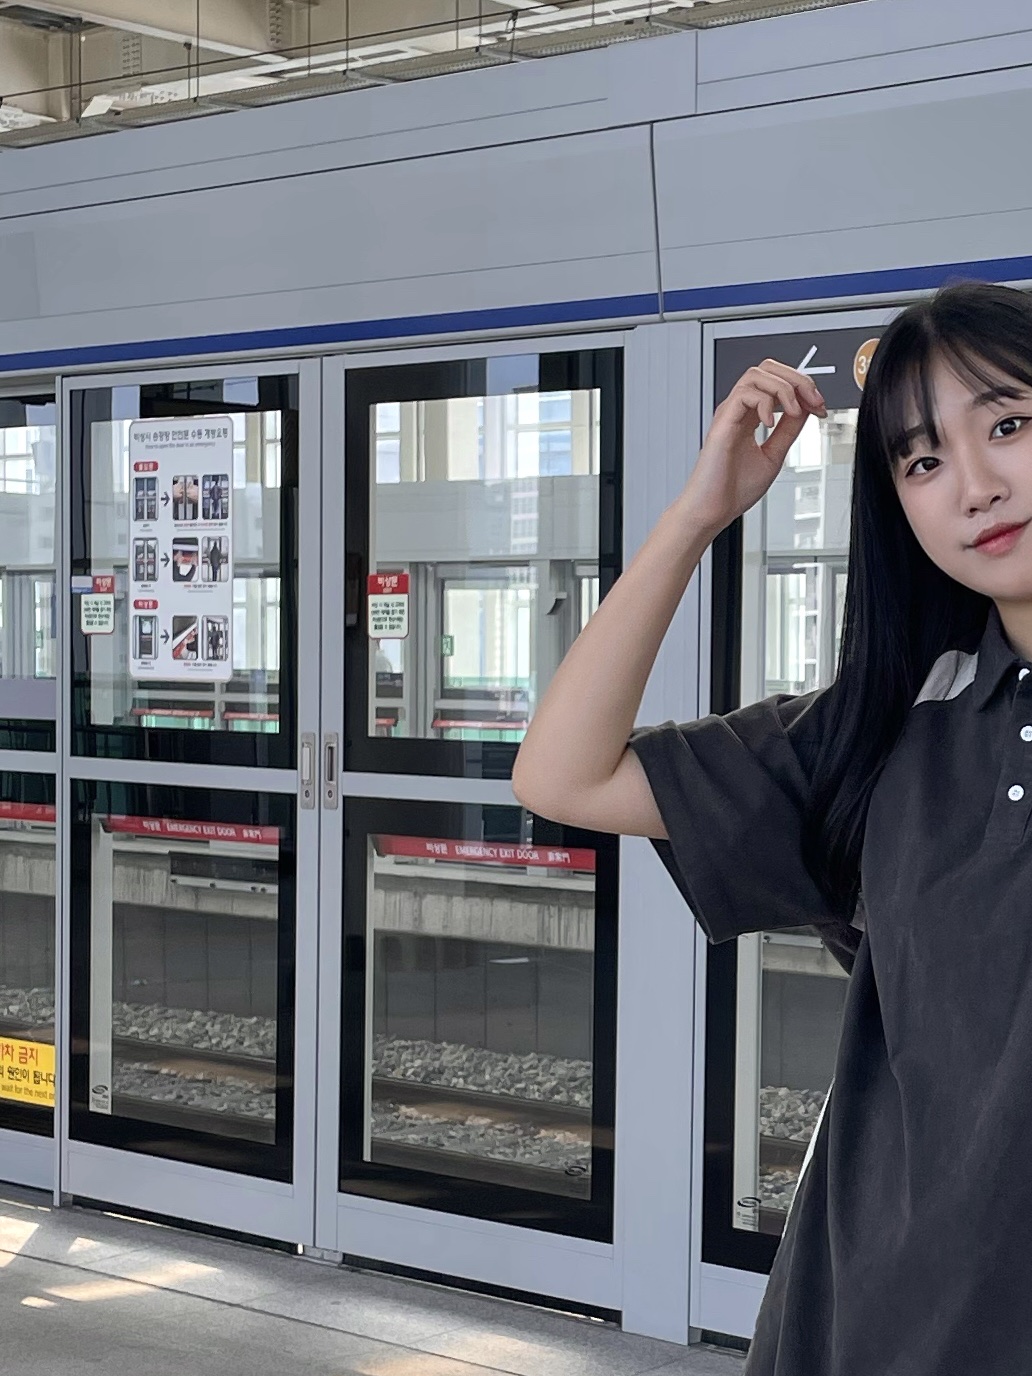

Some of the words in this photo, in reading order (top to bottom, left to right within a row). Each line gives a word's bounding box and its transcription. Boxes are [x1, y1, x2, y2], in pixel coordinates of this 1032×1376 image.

[166, 822, 202, 834] EMERGENCY
[202, 825, 216, 835] EXIT
[216, 826, 237, 837] DOOR
[454, 844, 498, 858] EMERGENCY
[498, 848, 515, 859] EXIT
[516, 848, 540, 860] DOOR
[18, 1045, 39, 1066] 금지
